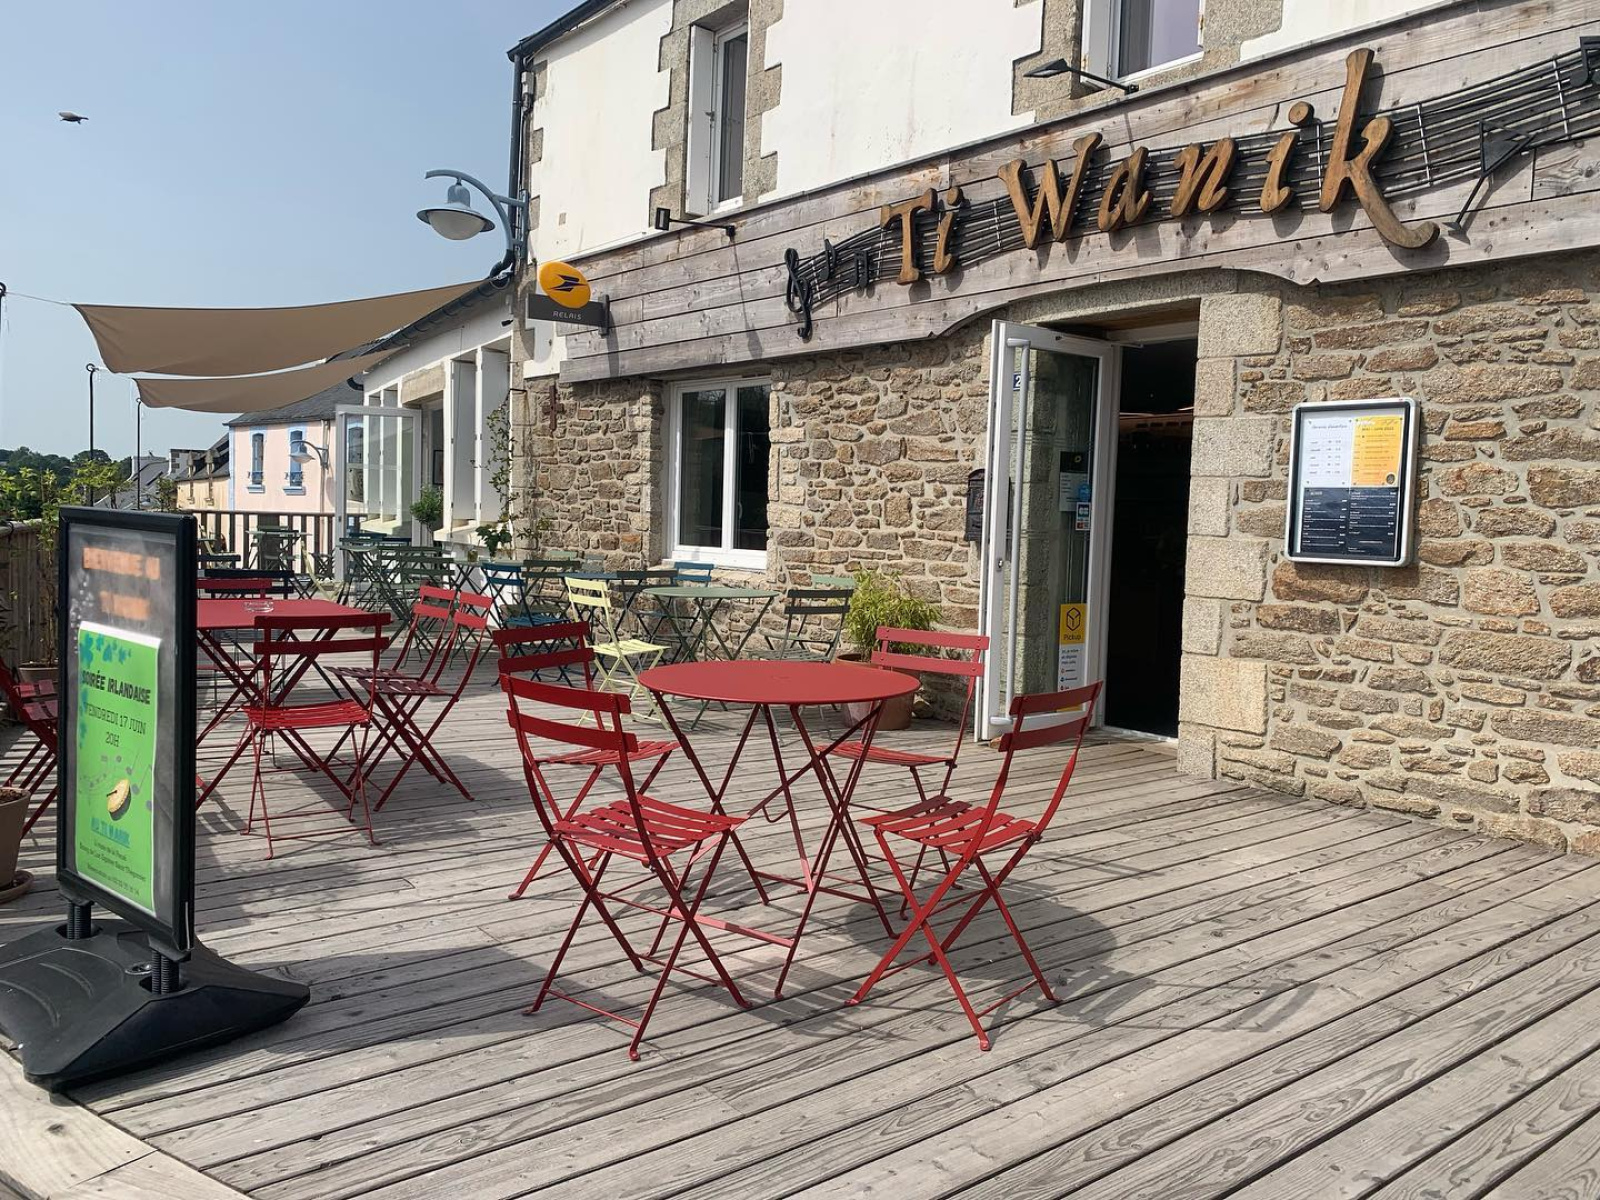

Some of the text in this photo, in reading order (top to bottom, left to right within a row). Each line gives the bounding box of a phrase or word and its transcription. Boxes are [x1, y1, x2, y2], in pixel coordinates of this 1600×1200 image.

[880, 48, 1440, 285] Ti Wanik
[552, 310, 582, 320] RELAIS
[1063, 633, 1082, 641] Pickup
[107, 677, 151, 705] IRLANDAISE
[119, 714, 129, 728] 17
[129, 717, 147, 735] JUIN
